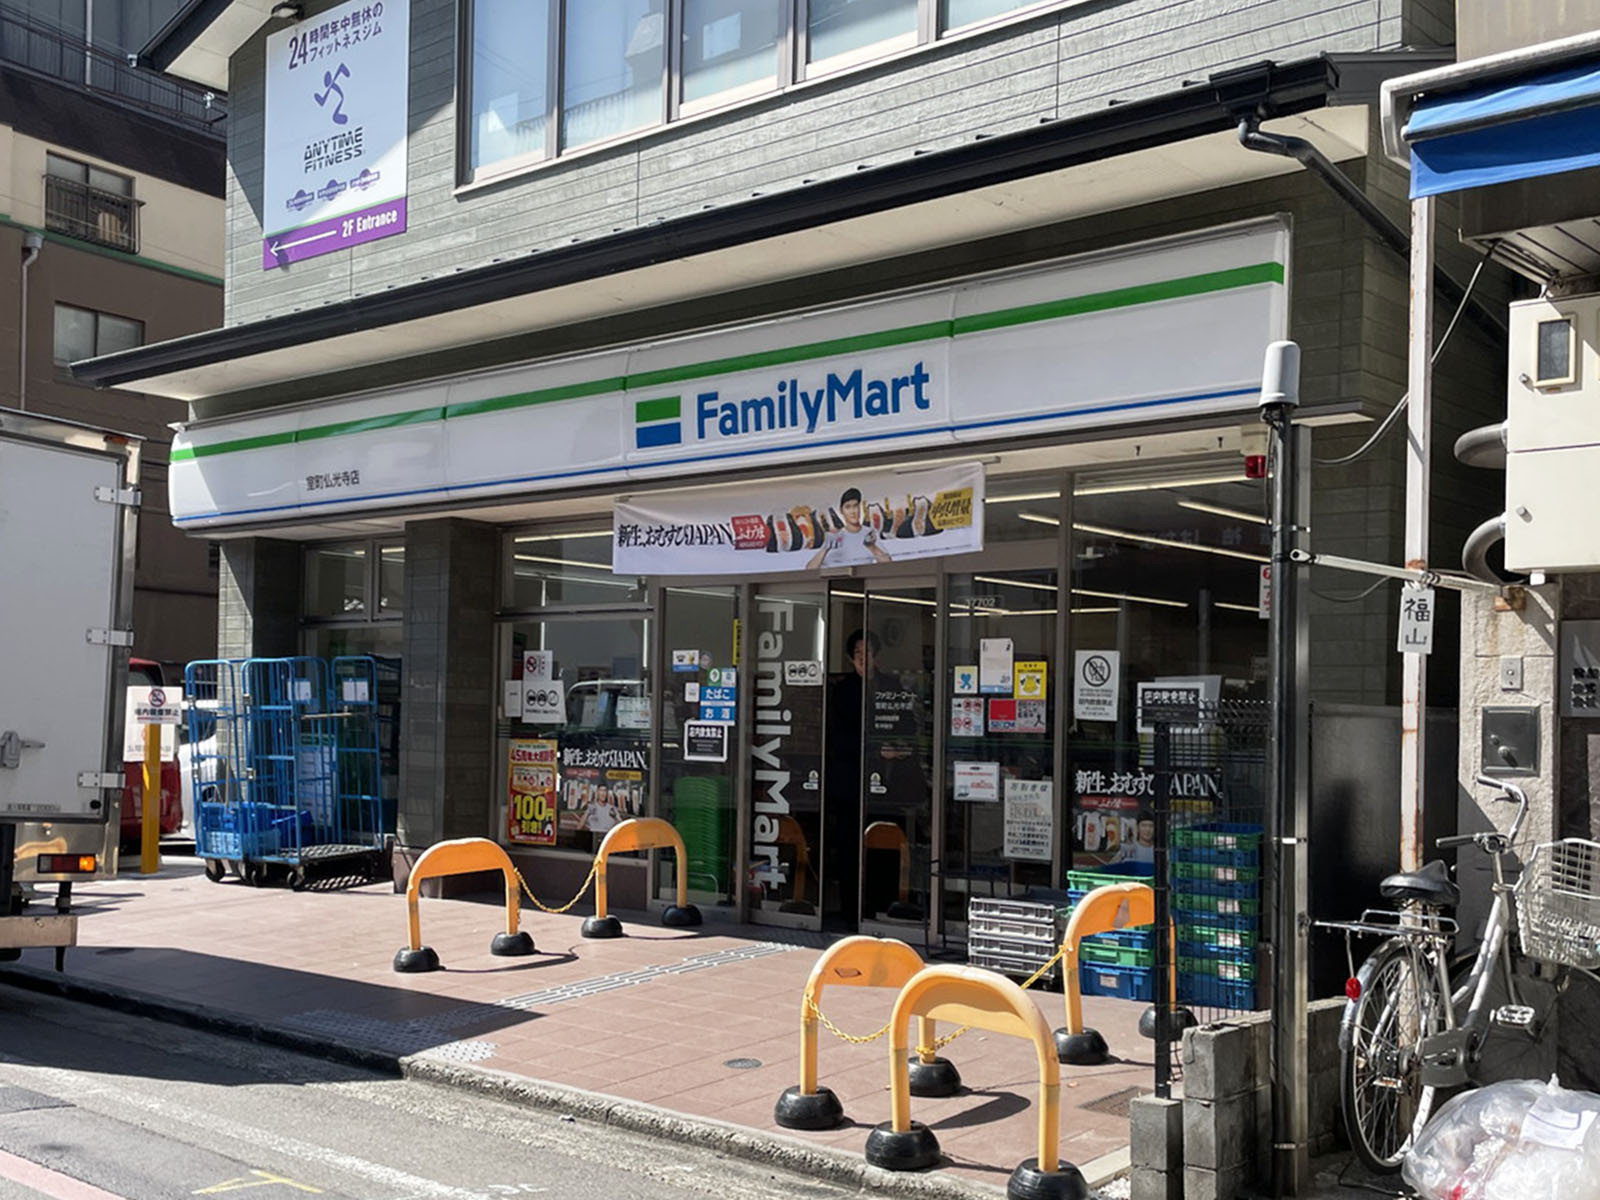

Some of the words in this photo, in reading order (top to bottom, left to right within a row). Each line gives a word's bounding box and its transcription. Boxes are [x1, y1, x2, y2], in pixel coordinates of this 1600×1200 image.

[304, 126, 363, 161] ANYTIME
[304, 144, 363, 173] FITNESS
[341, 219, 354, 238] 2F
[356, 209, 398, 233] Entrance
[697, 361, 930, 439] FamilyMart
[1403, 598, 1430, 645] 福山
[704, 688, 731, 700] たばこ
[751, 603, 794, 890] FamilyMart
